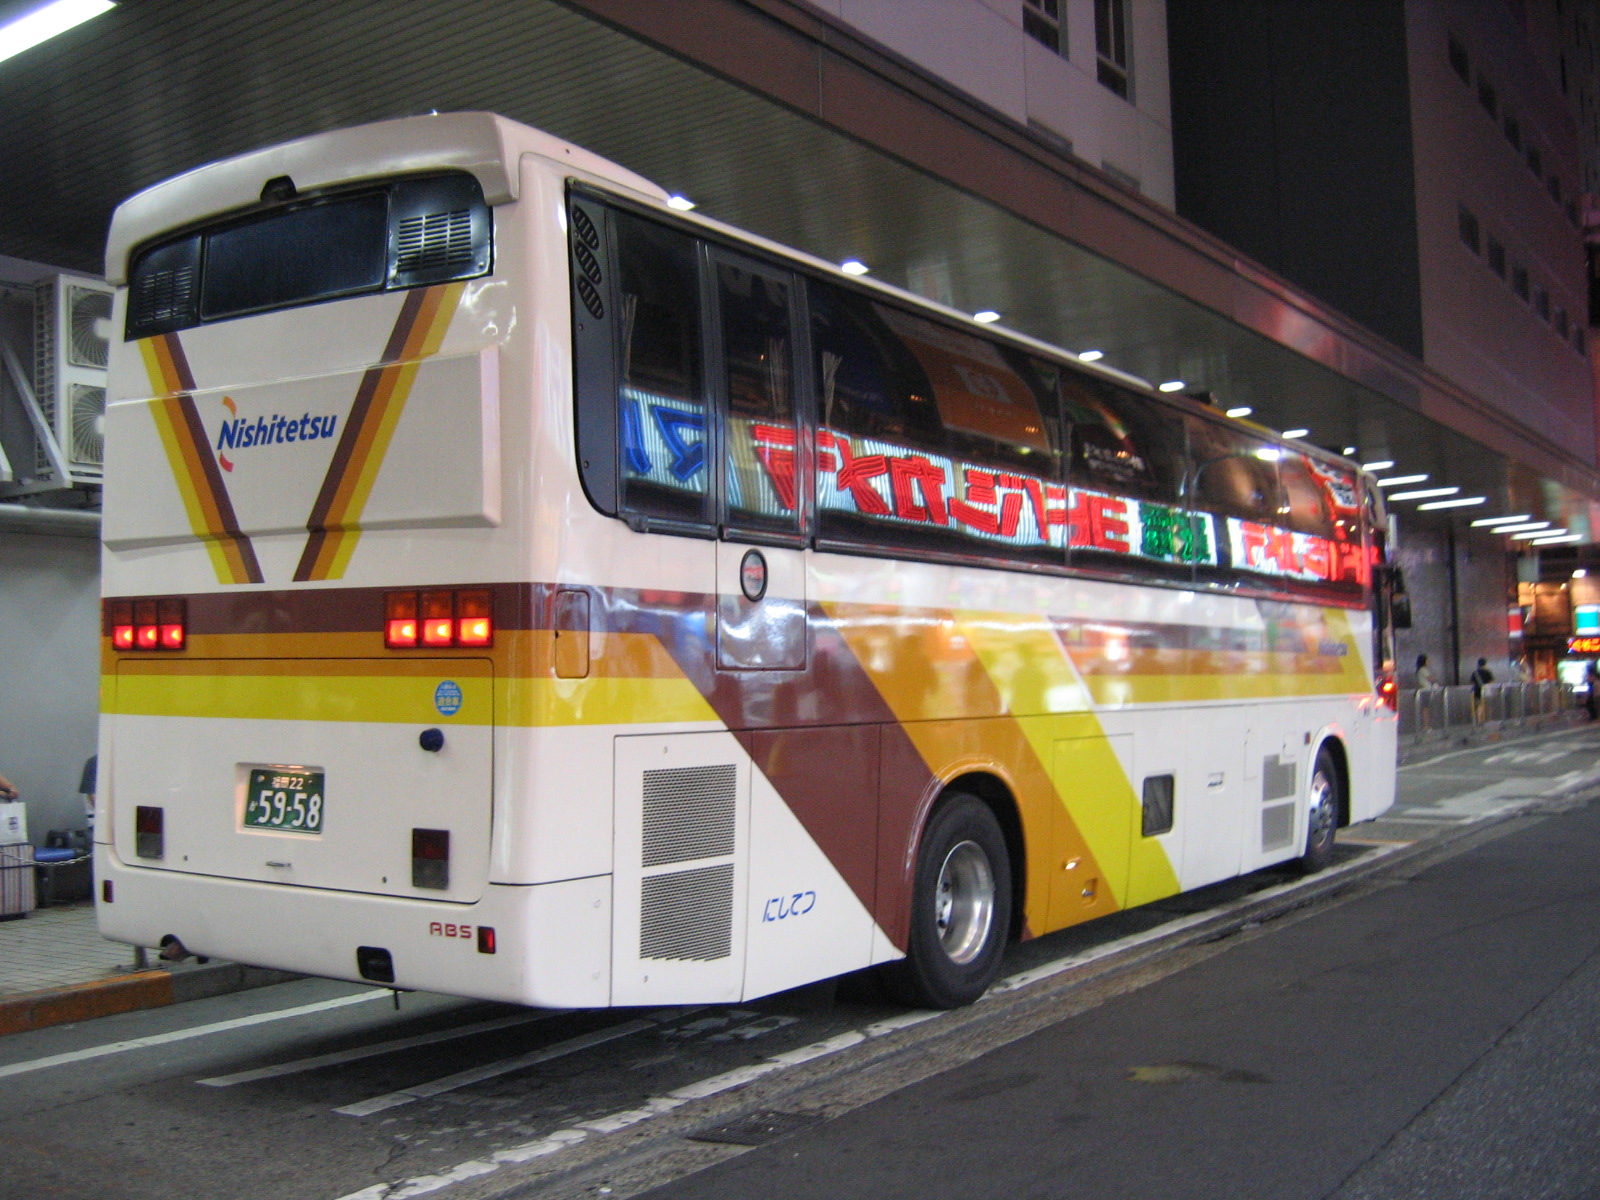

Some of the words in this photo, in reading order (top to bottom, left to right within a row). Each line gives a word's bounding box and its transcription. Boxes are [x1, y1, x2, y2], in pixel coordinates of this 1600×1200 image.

[217, 412, 337, 450] Nishitetsu
[258, 790, 321, 828] 59-58
[762, 890, 816, 923] にしてつ
[430, 922, 472, 938] ABS
